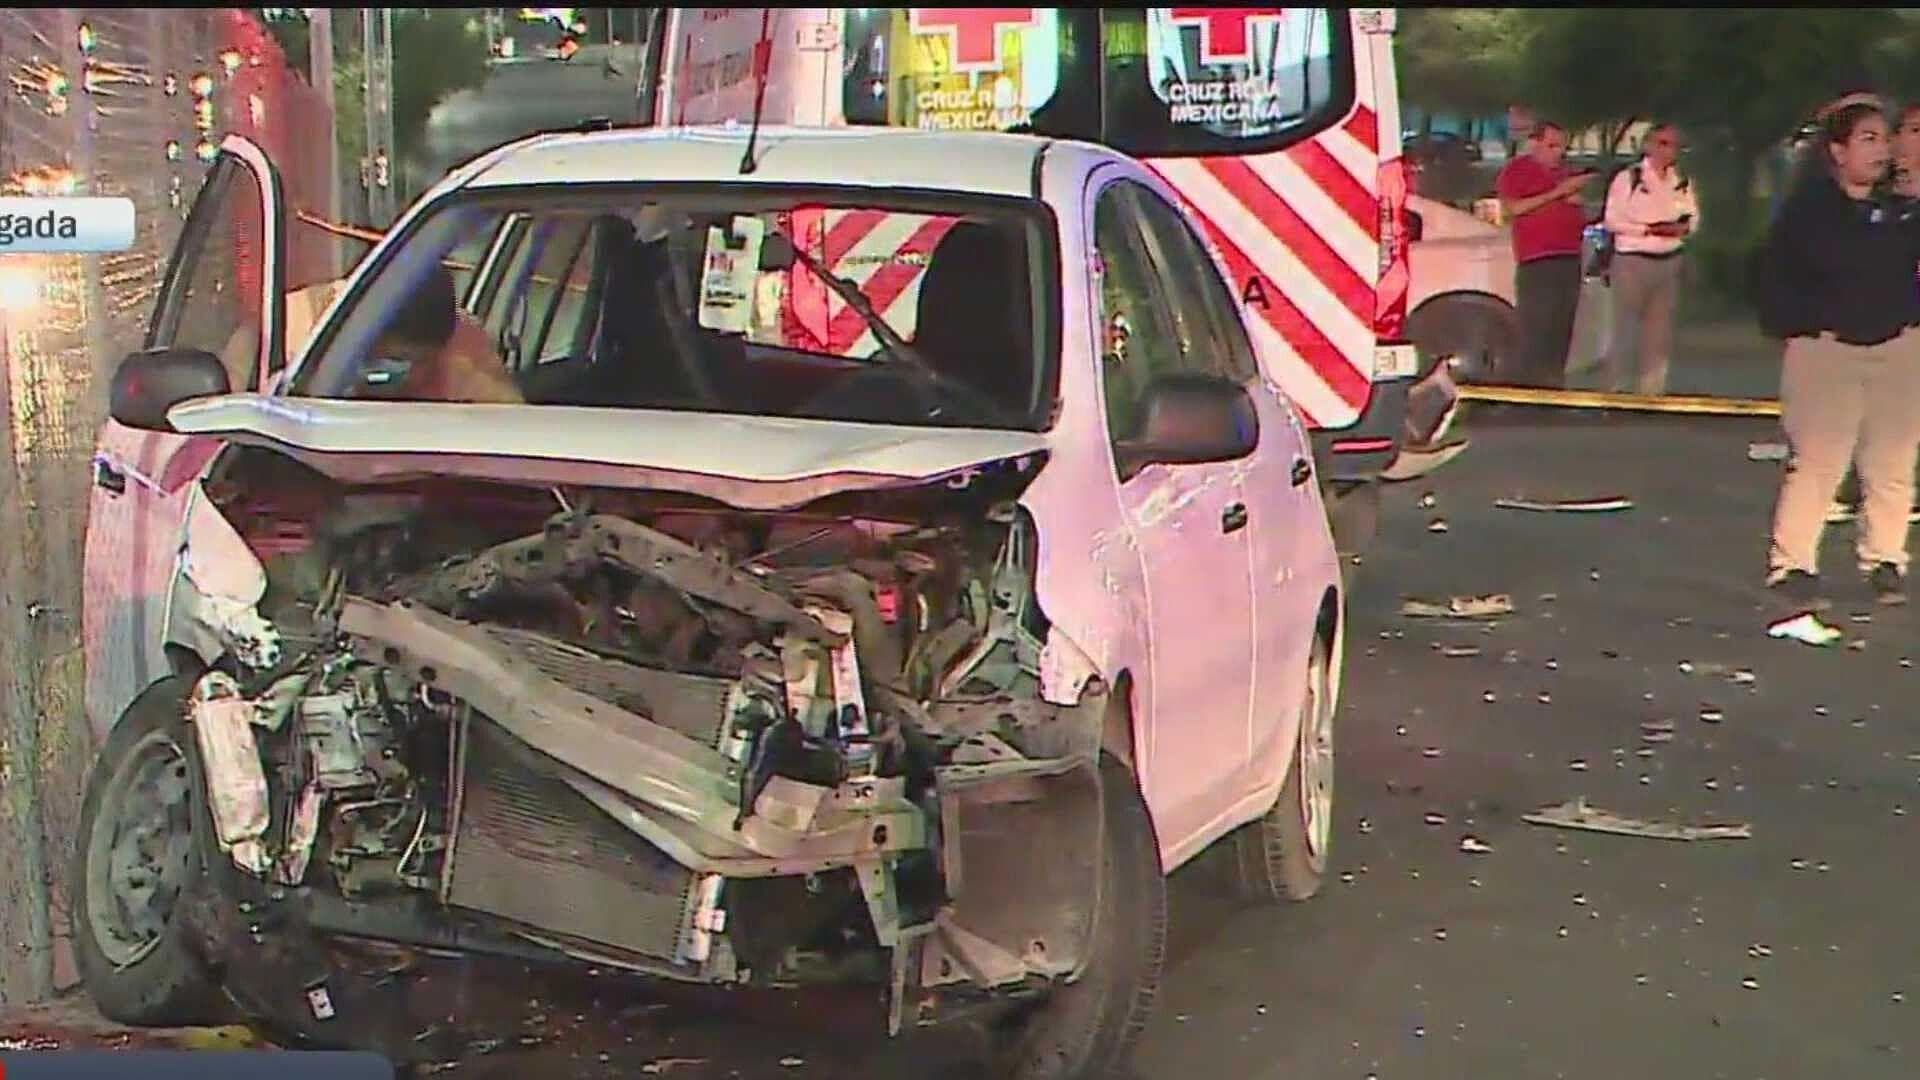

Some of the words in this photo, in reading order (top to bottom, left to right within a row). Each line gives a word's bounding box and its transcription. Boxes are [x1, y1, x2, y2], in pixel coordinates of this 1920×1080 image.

[918, 90, 976, 108] CRUZ
[1169, 82, 1224, 101] CRUZ
[1170, 102, 1282, 122] MEXICANA
